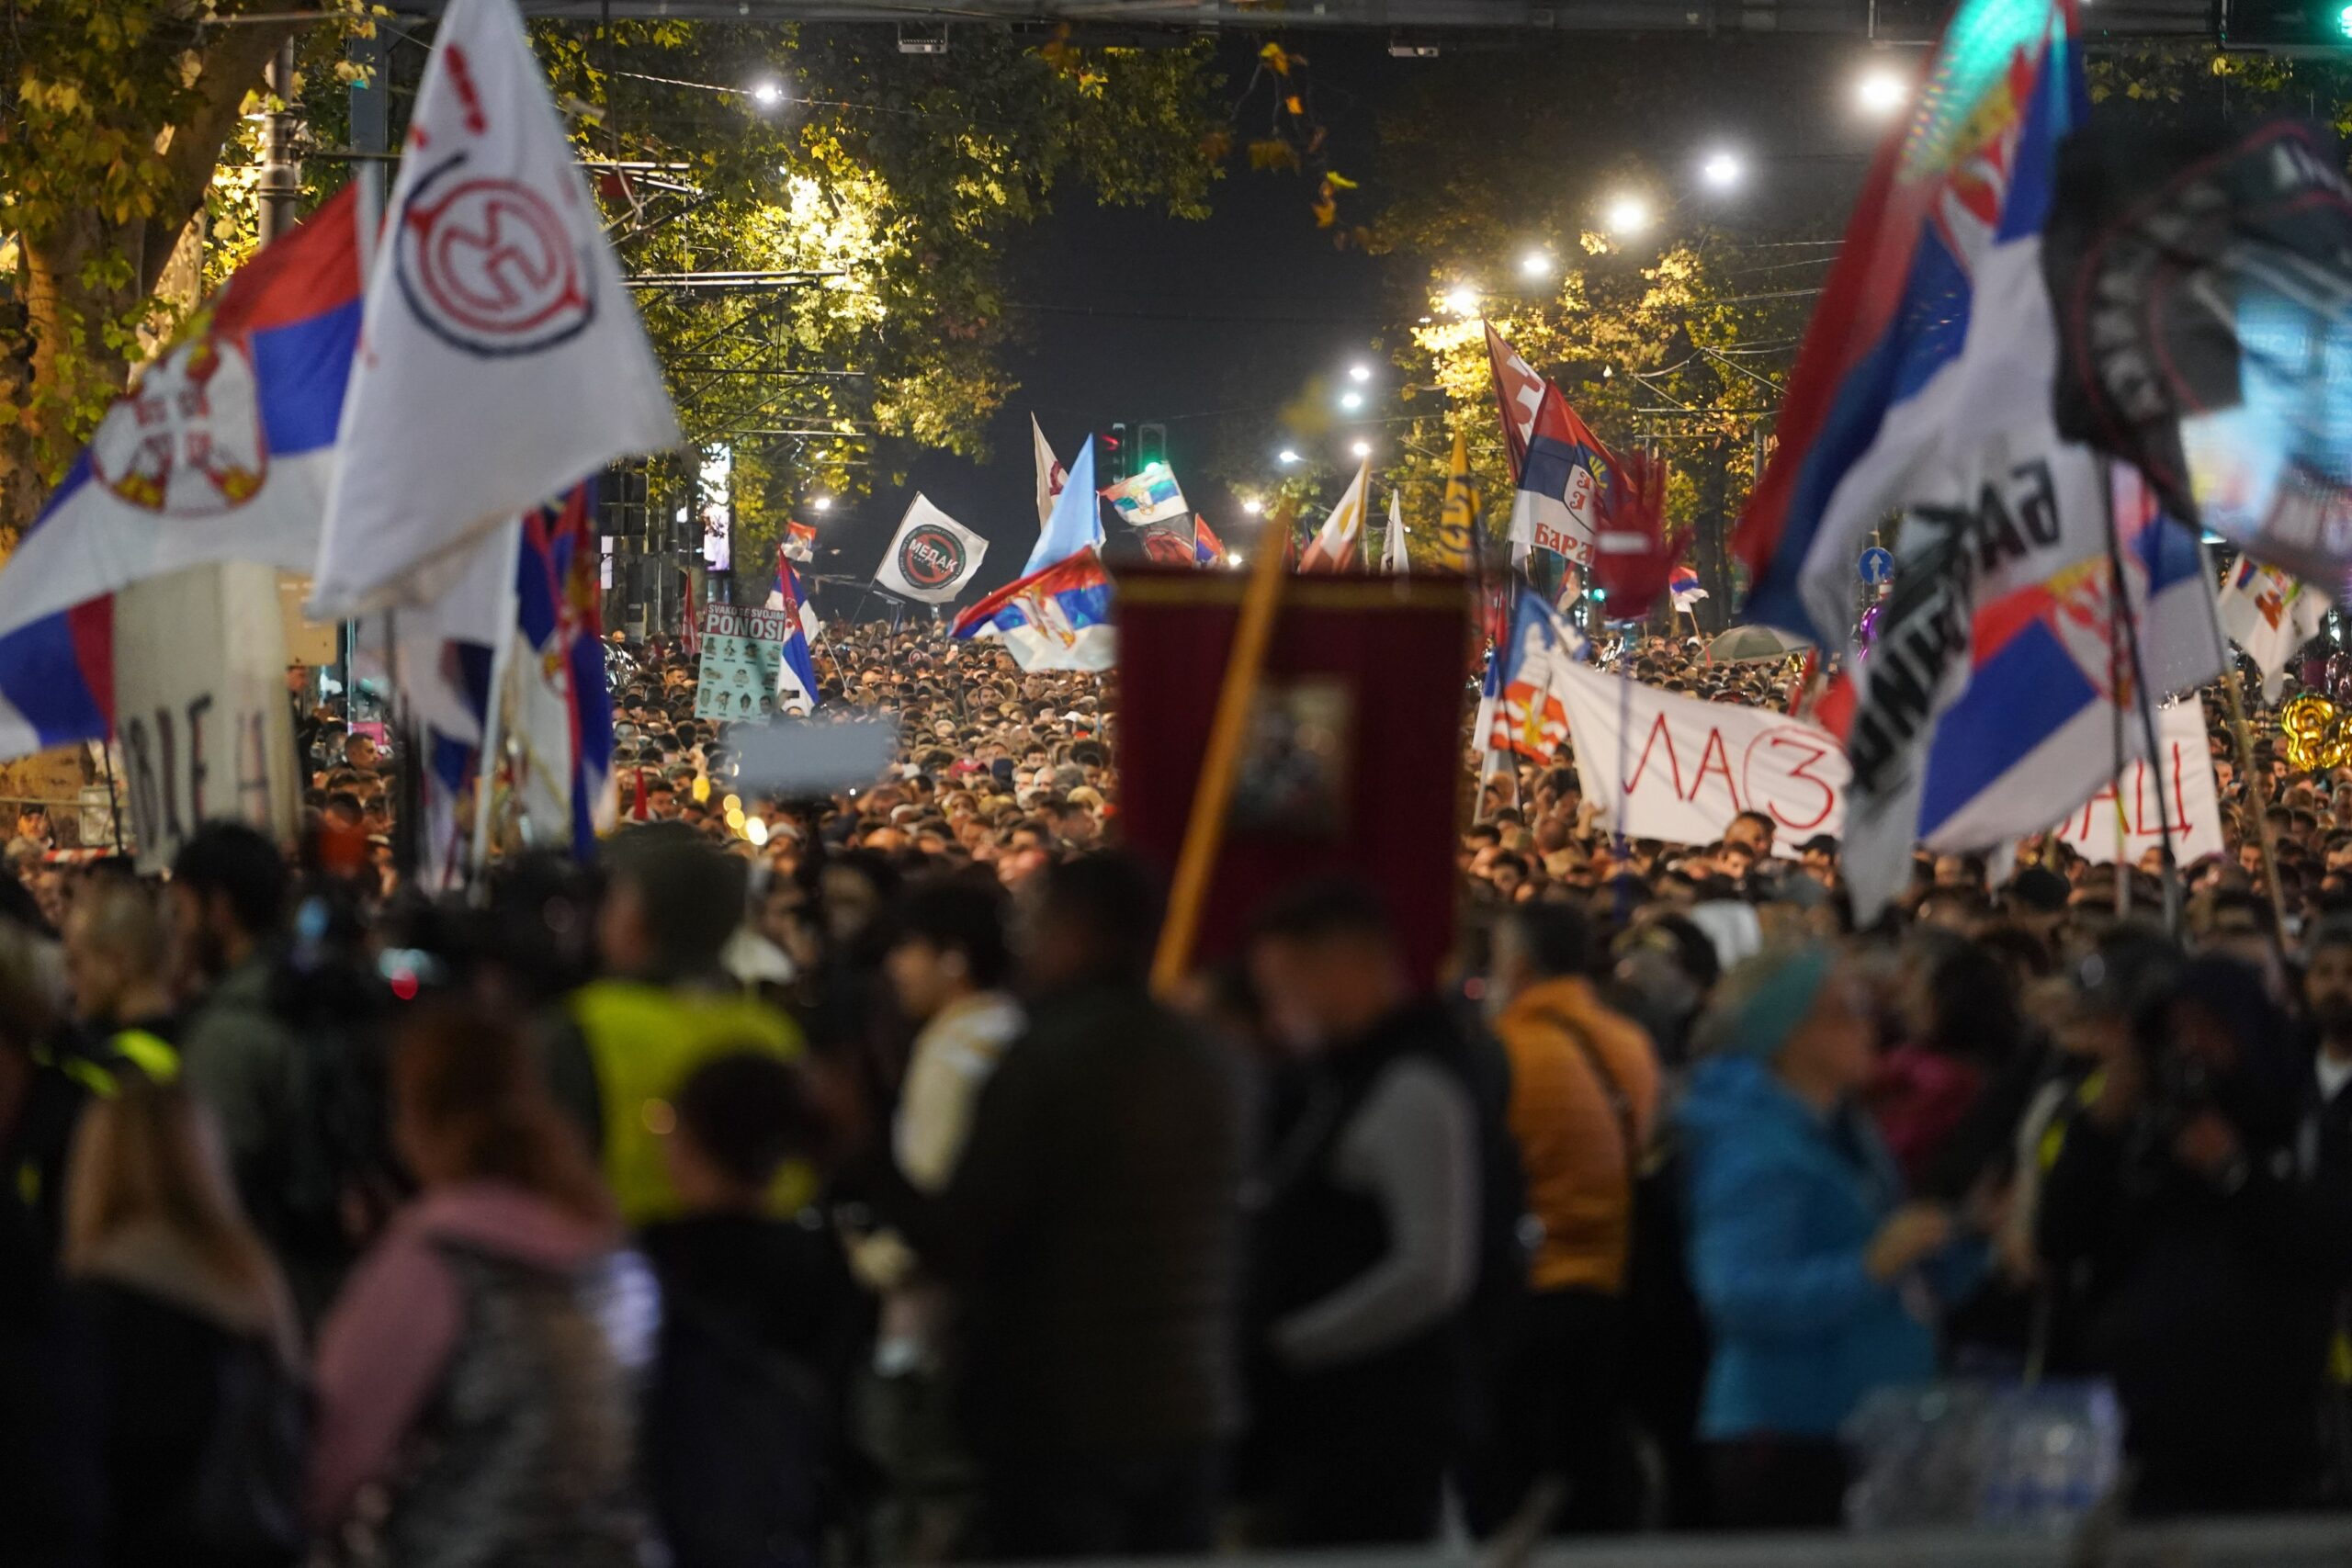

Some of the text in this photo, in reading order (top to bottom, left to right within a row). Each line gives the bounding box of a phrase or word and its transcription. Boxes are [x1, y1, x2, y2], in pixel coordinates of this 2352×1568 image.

[908, 538, 958, 572] МЕДАК
[708, 604, 737, 615] SVAKO
[751, 608, 785, 620] SVOJIM
[707, 615, 784, 641] PONOSI
